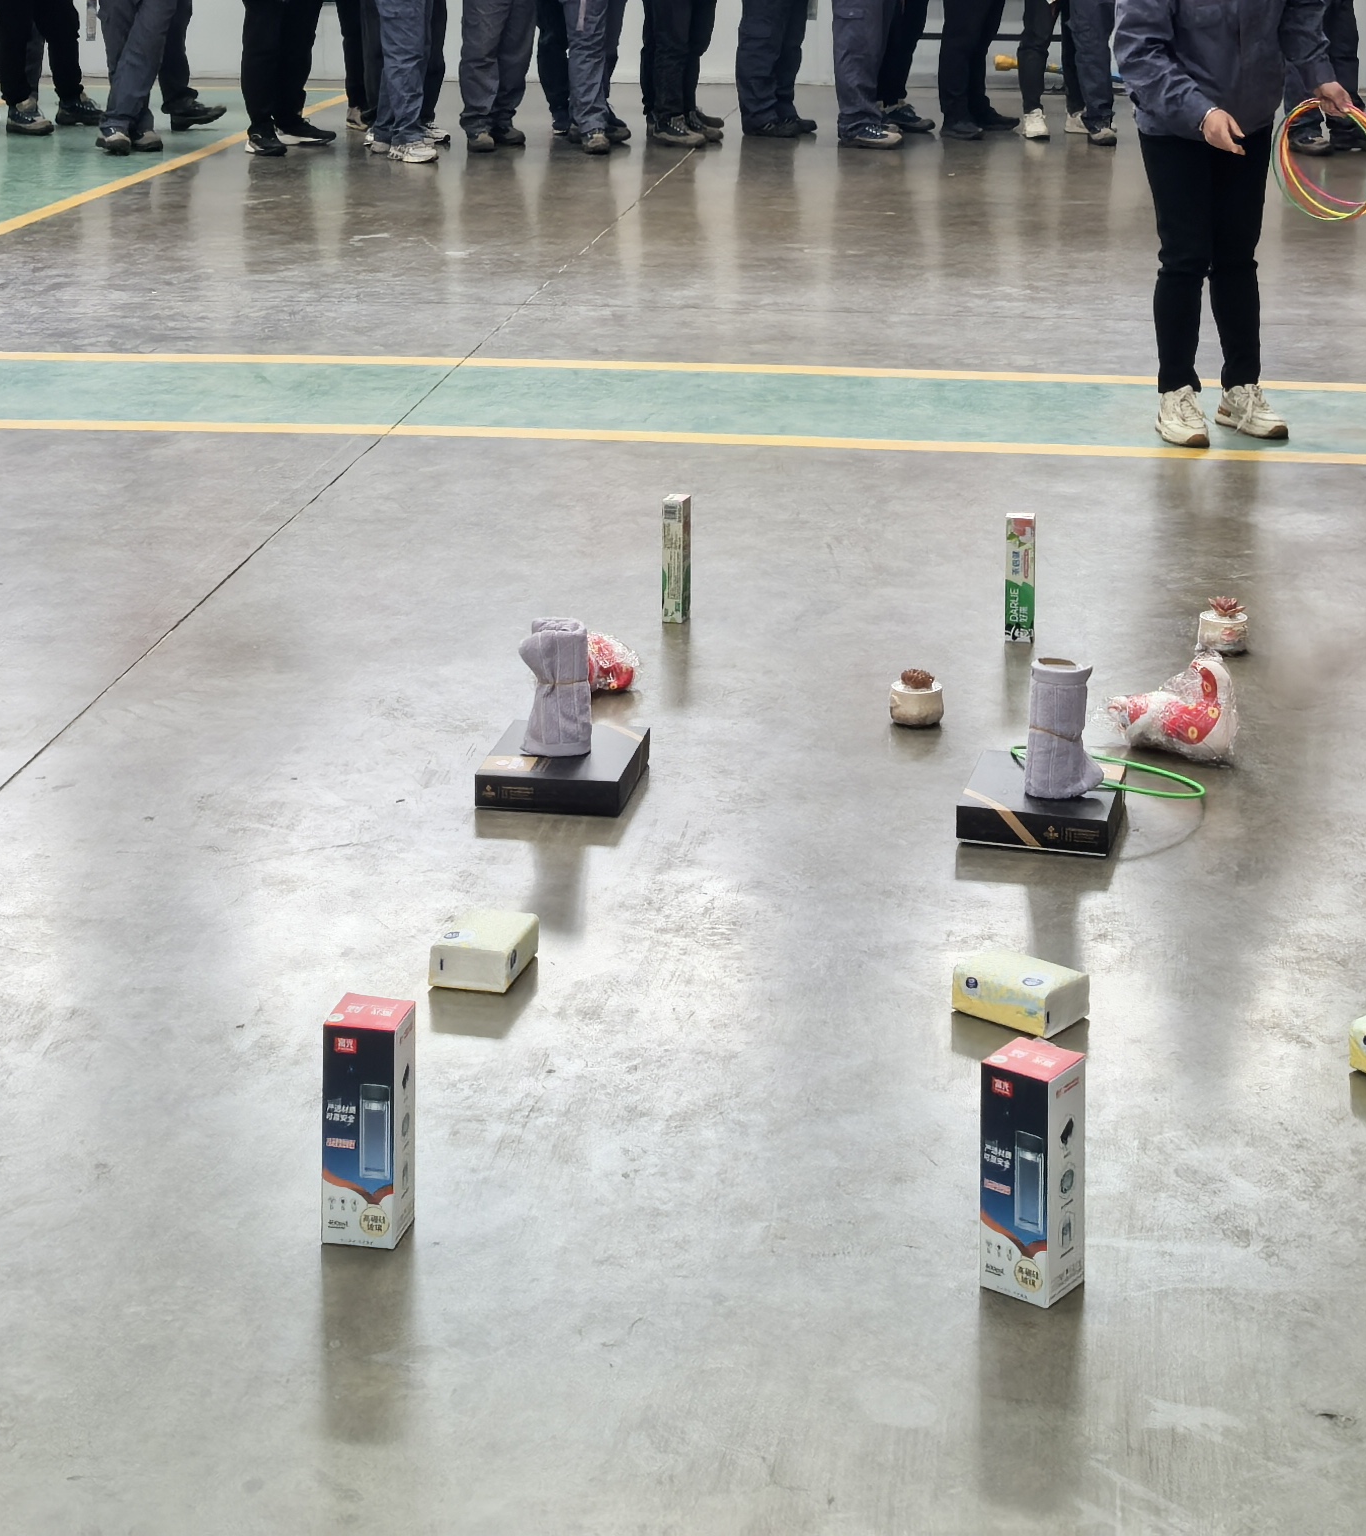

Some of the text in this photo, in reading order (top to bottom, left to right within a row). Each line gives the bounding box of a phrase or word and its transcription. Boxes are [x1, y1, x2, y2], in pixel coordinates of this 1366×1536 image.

[1010, 587, 1020, 622] DARLIE
[338, 1037, 354, 1049] 富光
[994, 1078, 1010, 1092] 富光
